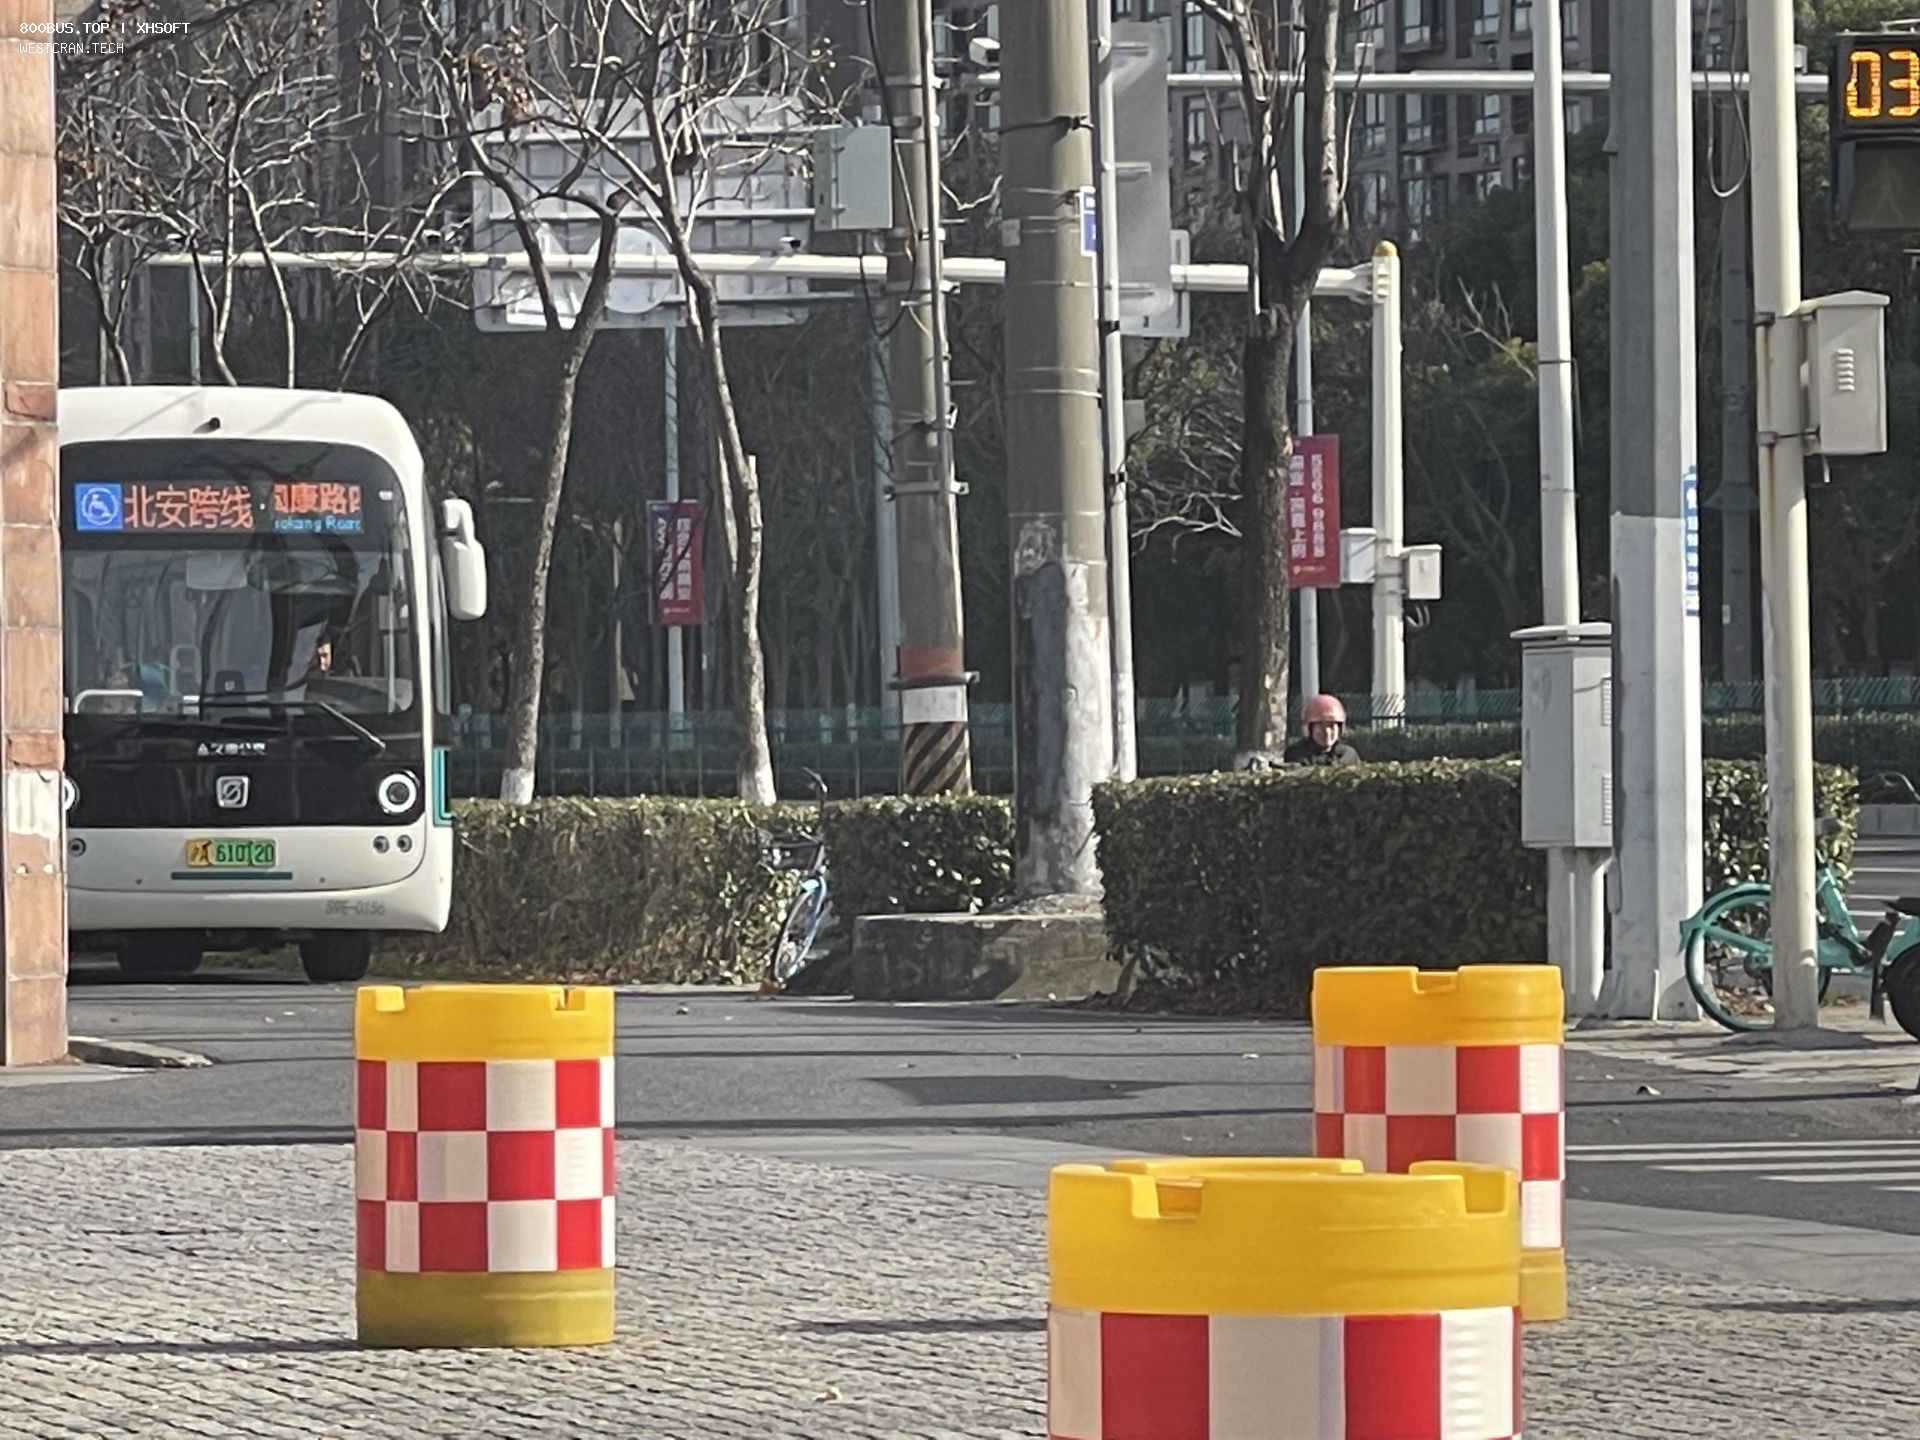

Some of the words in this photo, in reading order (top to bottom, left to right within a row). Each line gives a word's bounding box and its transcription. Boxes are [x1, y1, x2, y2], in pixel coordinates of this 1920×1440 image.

[1845, 50, 1920, 117] 03
[124, 484, 254, 529] 北安跨线
